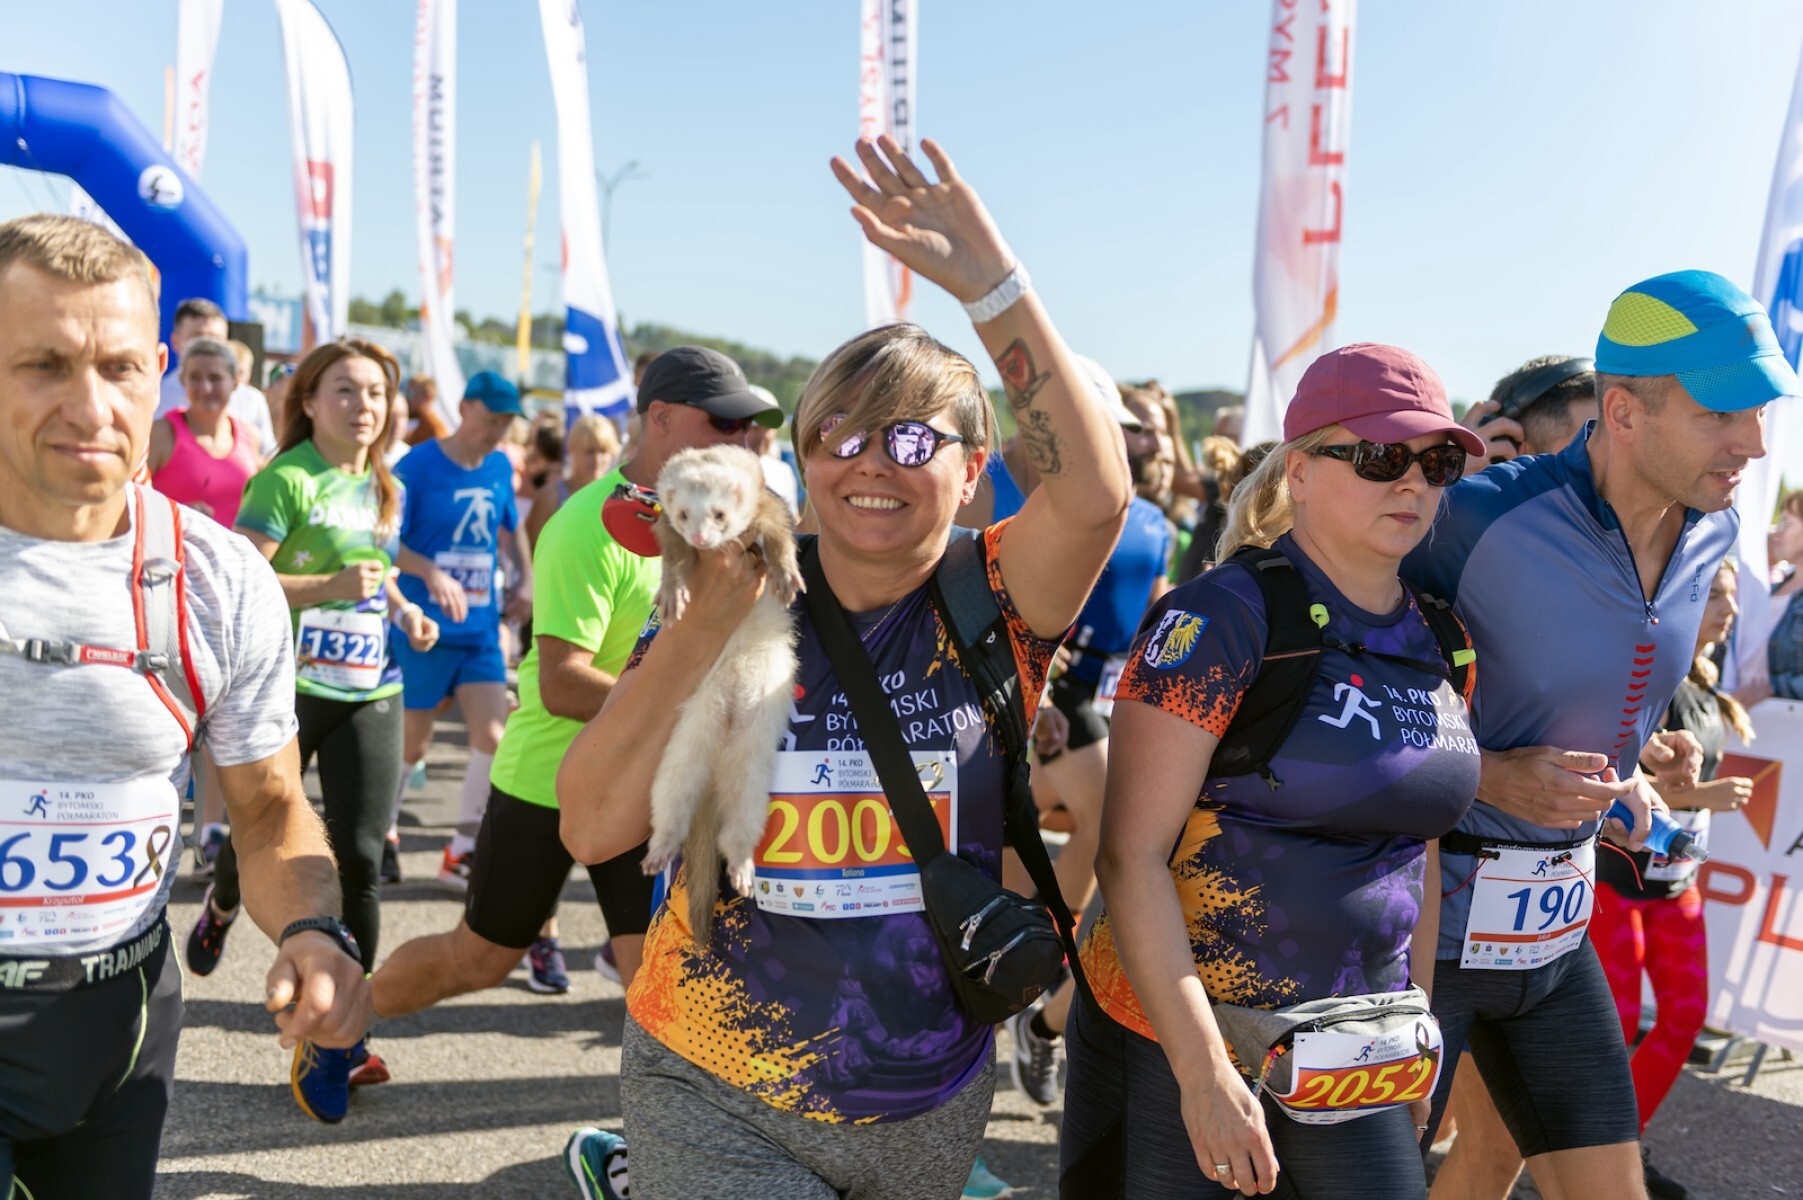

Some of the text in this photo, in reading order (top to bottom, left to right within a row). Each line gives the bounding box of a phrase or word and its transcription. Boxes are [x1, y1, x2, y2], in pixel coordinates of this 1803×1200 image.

[306, 629, 380, 665] 1322
[1383, 684, 1442, 707] 14. PKO
[1392, 705, 1469, 731] BYTOMSKI
[849, 759, 863, 767] PKO
[75, 791, 95, 800] PKO
[763, 799, 937, 865] 200
[0, 830, 137, 892] 653
[1507, 880, 1586, 932] 190
[80, 922, 163, 984] TRAINING
[1286, 1057, 1432, 1108] 2052
